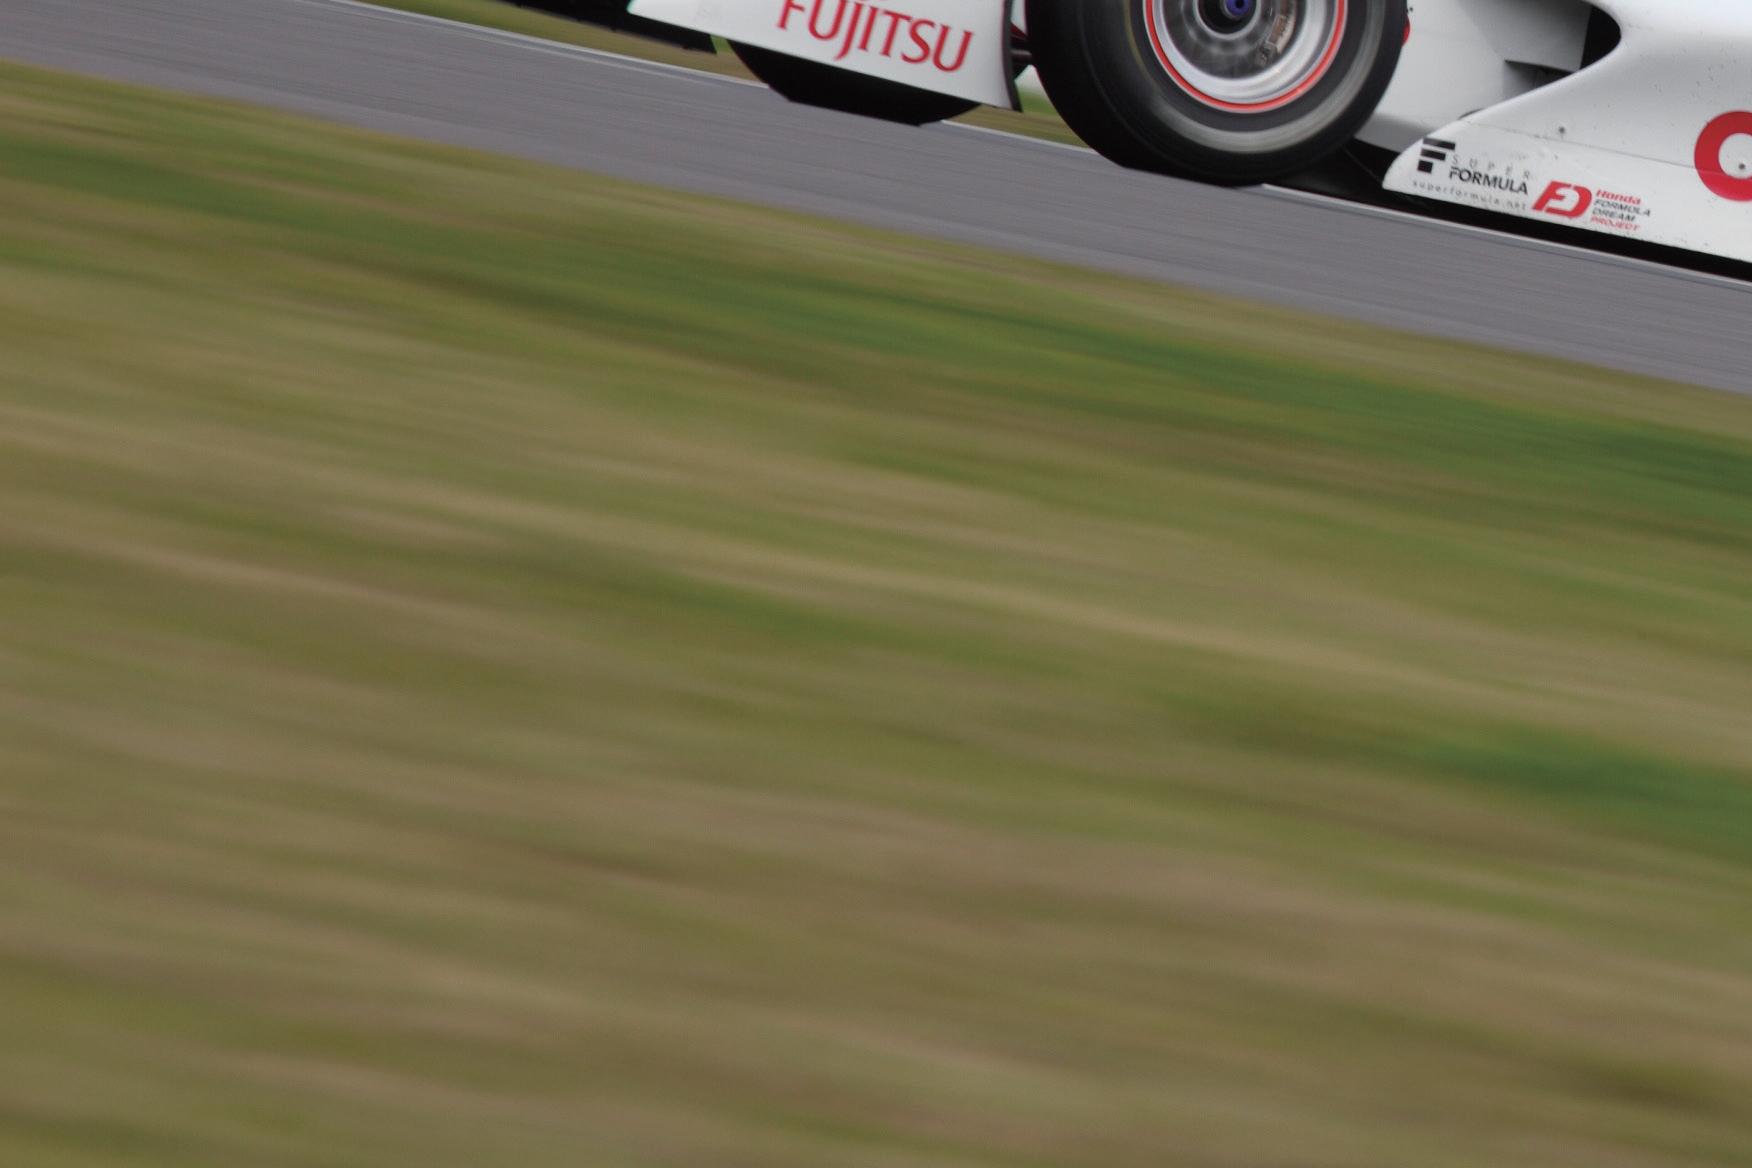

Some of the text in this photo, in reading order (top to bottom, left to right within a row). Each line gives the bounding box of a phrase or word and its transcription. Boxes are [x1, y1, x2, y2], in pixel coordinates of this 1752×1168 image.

[1451, 154, 1531, 180] SUPER
[1448, 165, 1528, 196] FORMULA
[1594, 198, 1651, 217] FORMULA
[1596, 188, 1641, 205] Honda
